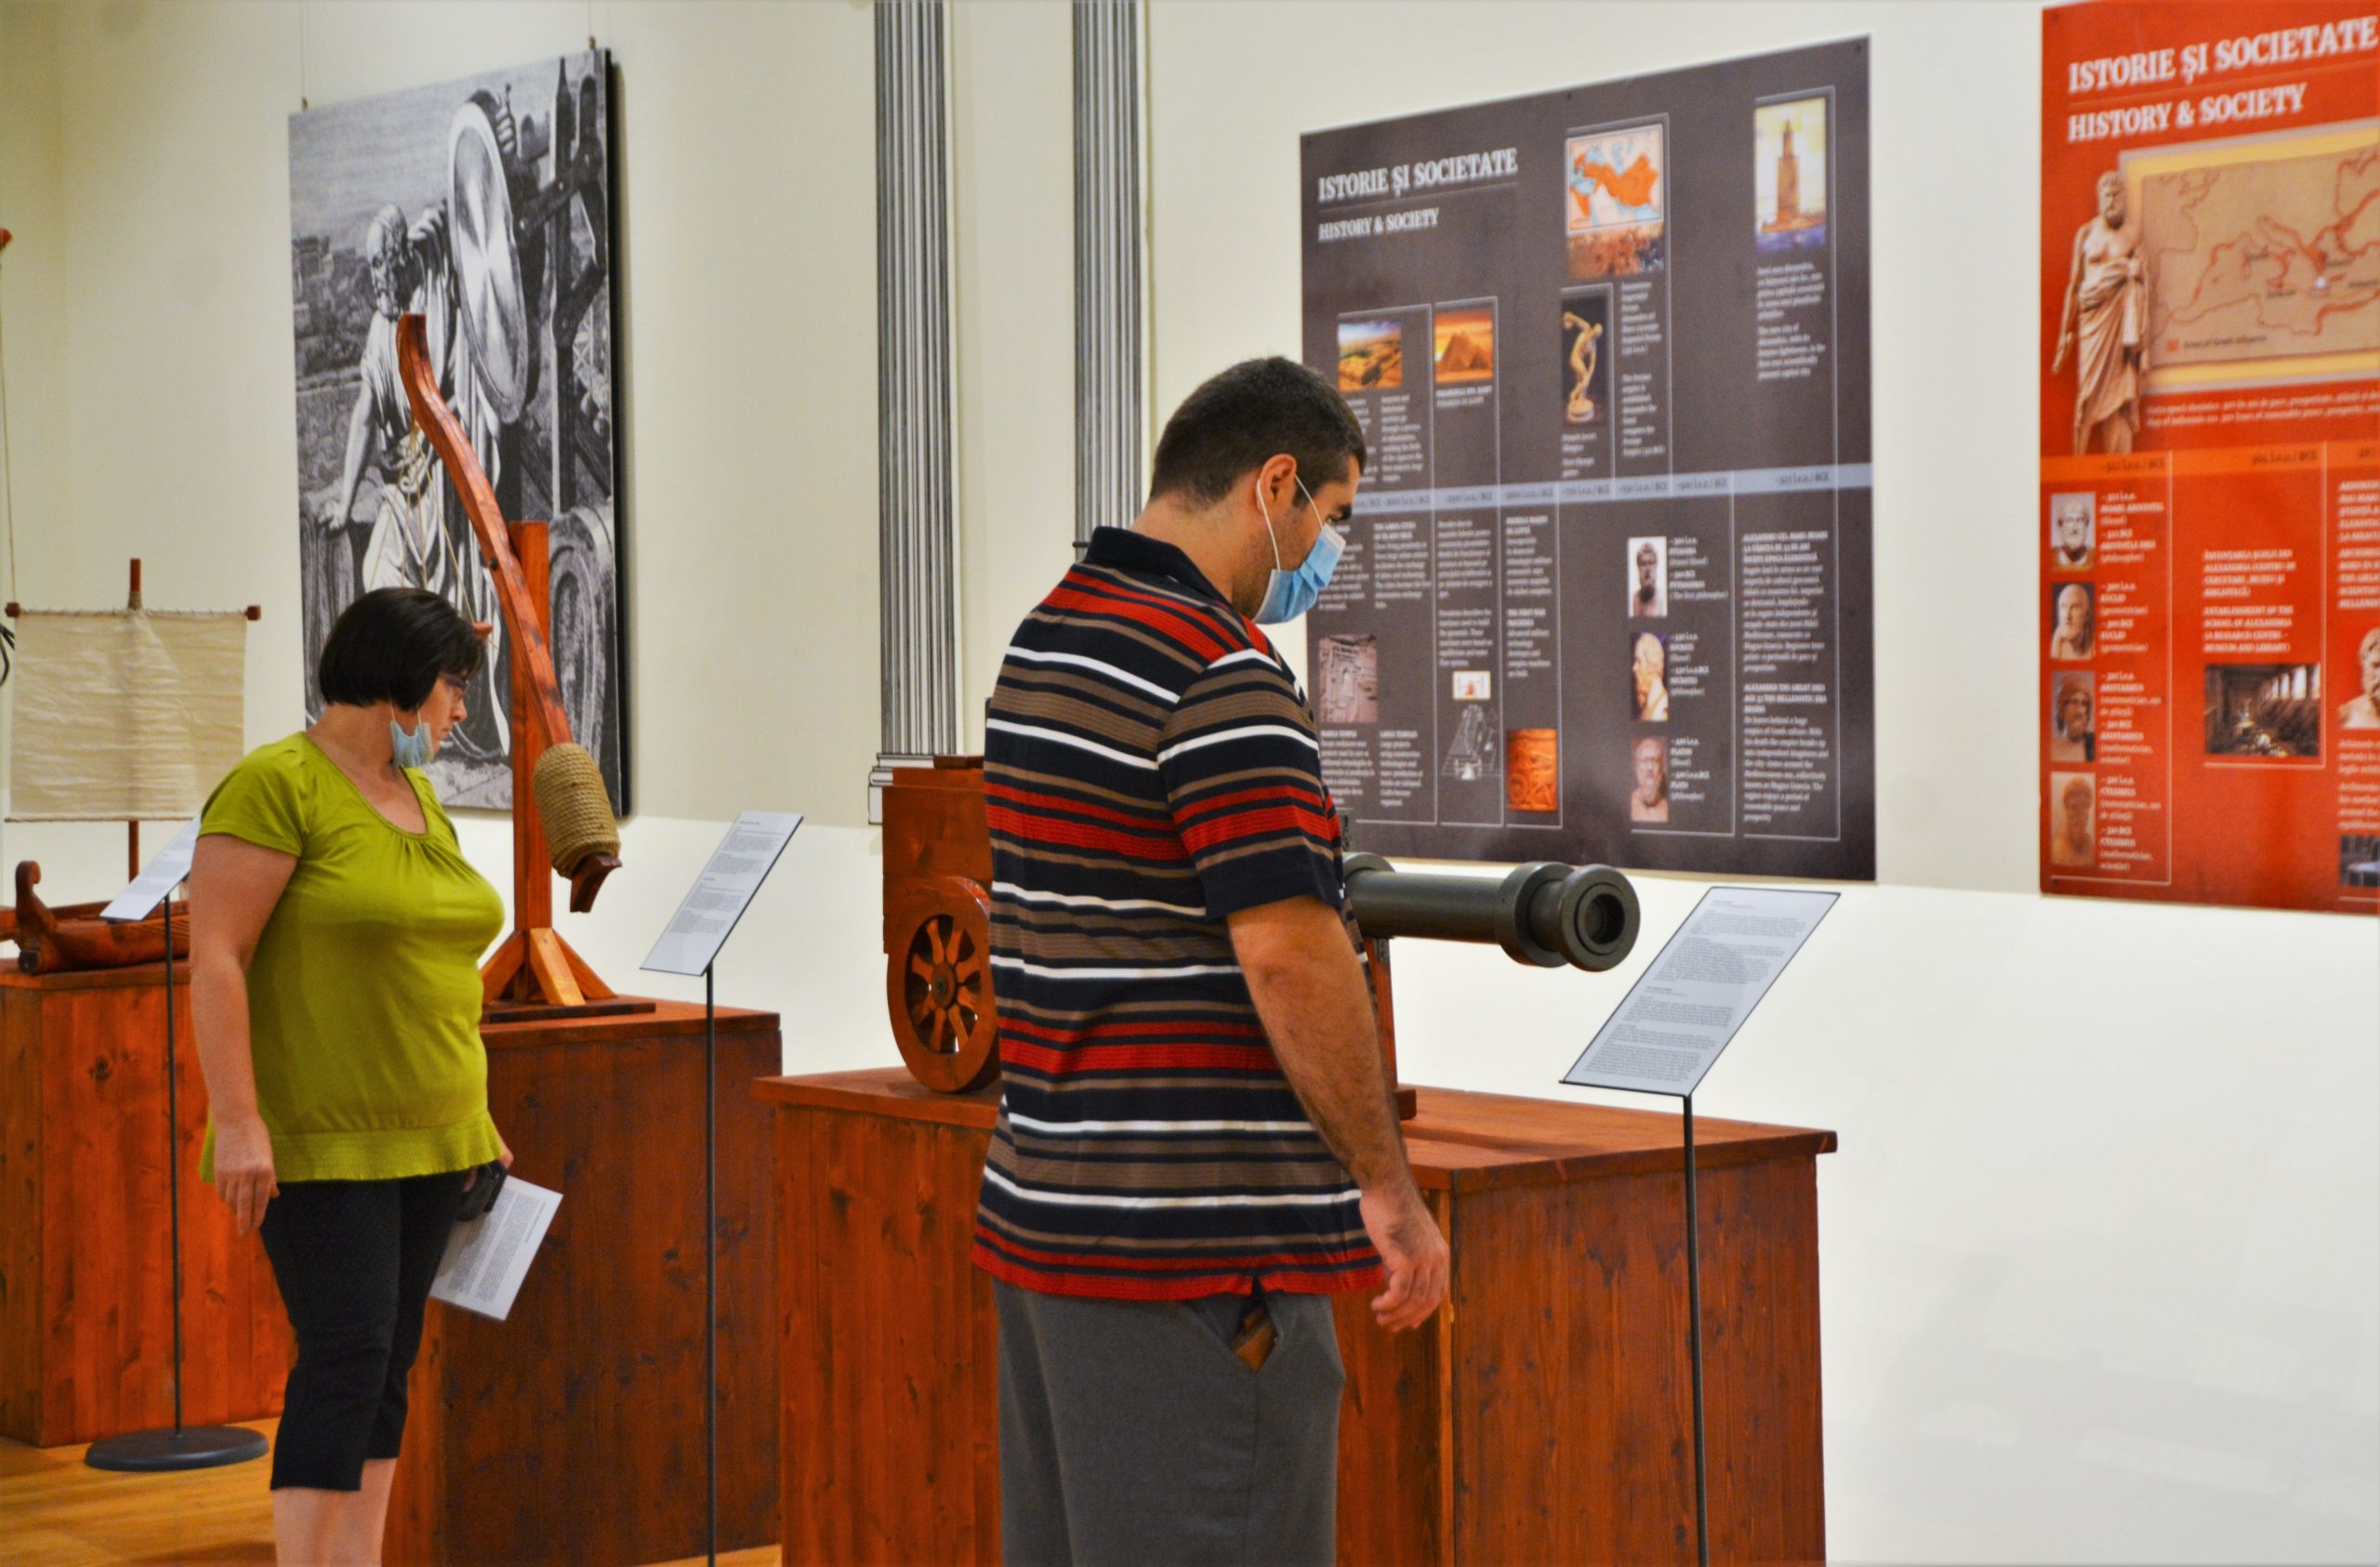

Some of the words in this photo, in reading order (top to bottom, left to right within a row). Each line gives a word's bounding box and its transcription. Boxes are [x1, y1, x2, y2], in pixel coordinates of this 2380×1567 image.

[2069, 47, 2175, 94] ISTORIE
[2215, 15, 2379, 72] SOCIETATE
[2069, 101, 2173, 143] HISTORY
[2175, 99, 2194, 129] &
[2199, 82, 2307, 125] SOCIETY
[1318, 168, 1389, 203] ISTORIE
[1413, 148, 1518, 187] SOCIETATE
[1318, 216, 1372, 242] HISTORY
[1374, 215, 1383, 233] &
[1385, 207, 1439, 232] SOCIETY
